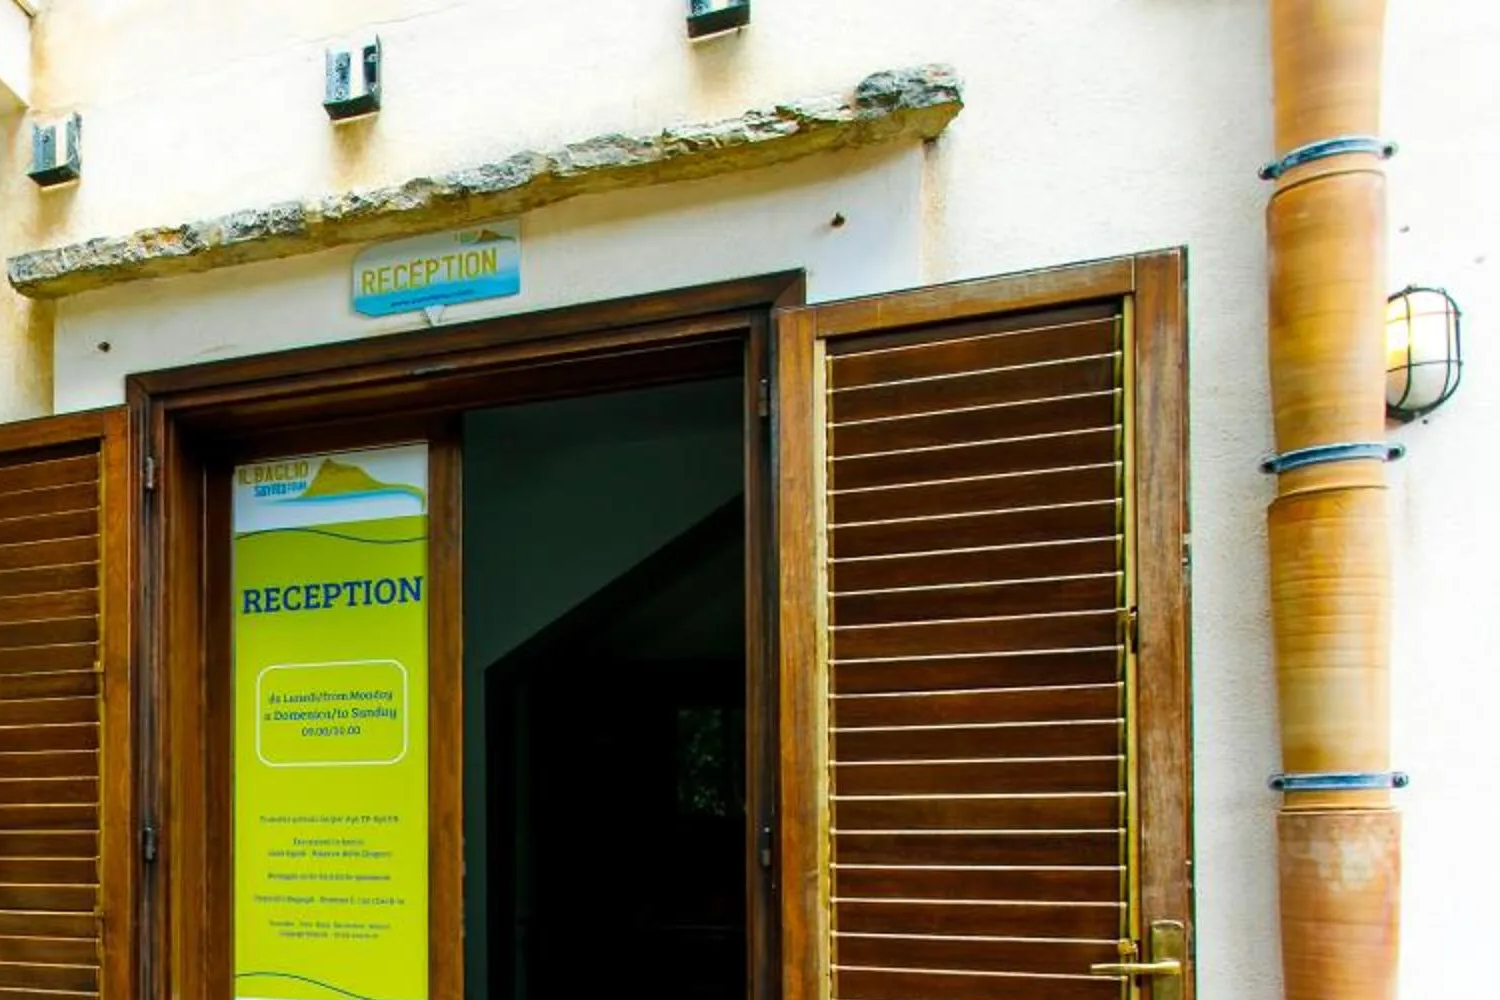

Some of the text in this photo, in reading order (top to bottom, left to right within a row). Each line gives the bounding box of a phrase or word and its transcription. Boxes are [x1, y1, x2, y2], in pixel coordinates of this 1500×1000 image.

[361, 248, 497, 294] RECEPTION
[243, 575, 423, 614] RECEPTION
[351, 704, 397, 720] Sunday
